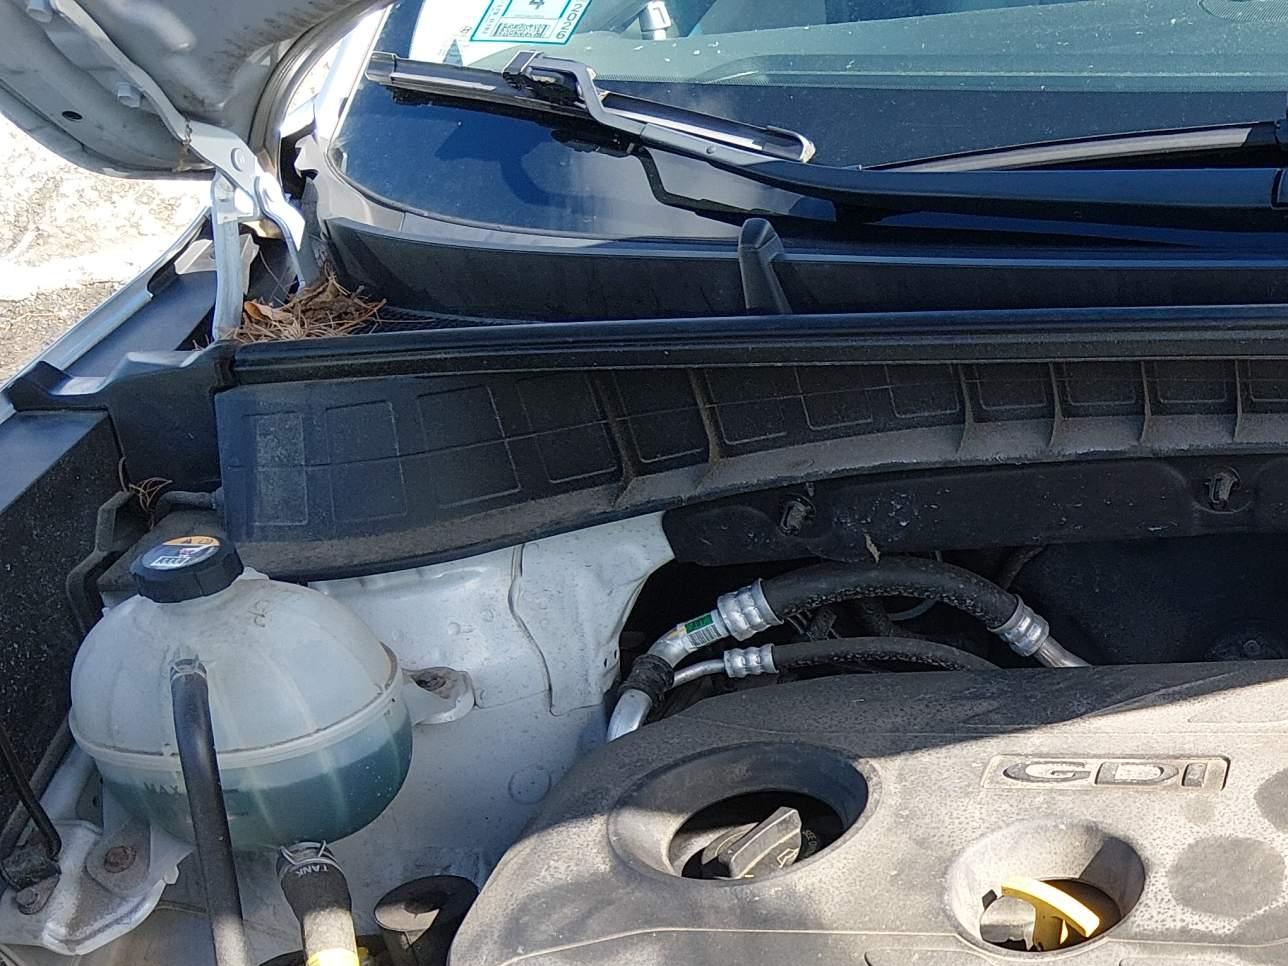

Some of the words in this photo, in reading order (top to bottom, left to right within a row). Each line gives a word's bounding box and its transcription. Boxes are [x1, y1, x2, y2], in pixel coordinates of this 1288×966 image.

[556, 3, 583, 39] 2026
[1002, 760, 1208, 788] GDI
[296, 864, 329, 878] TANK
